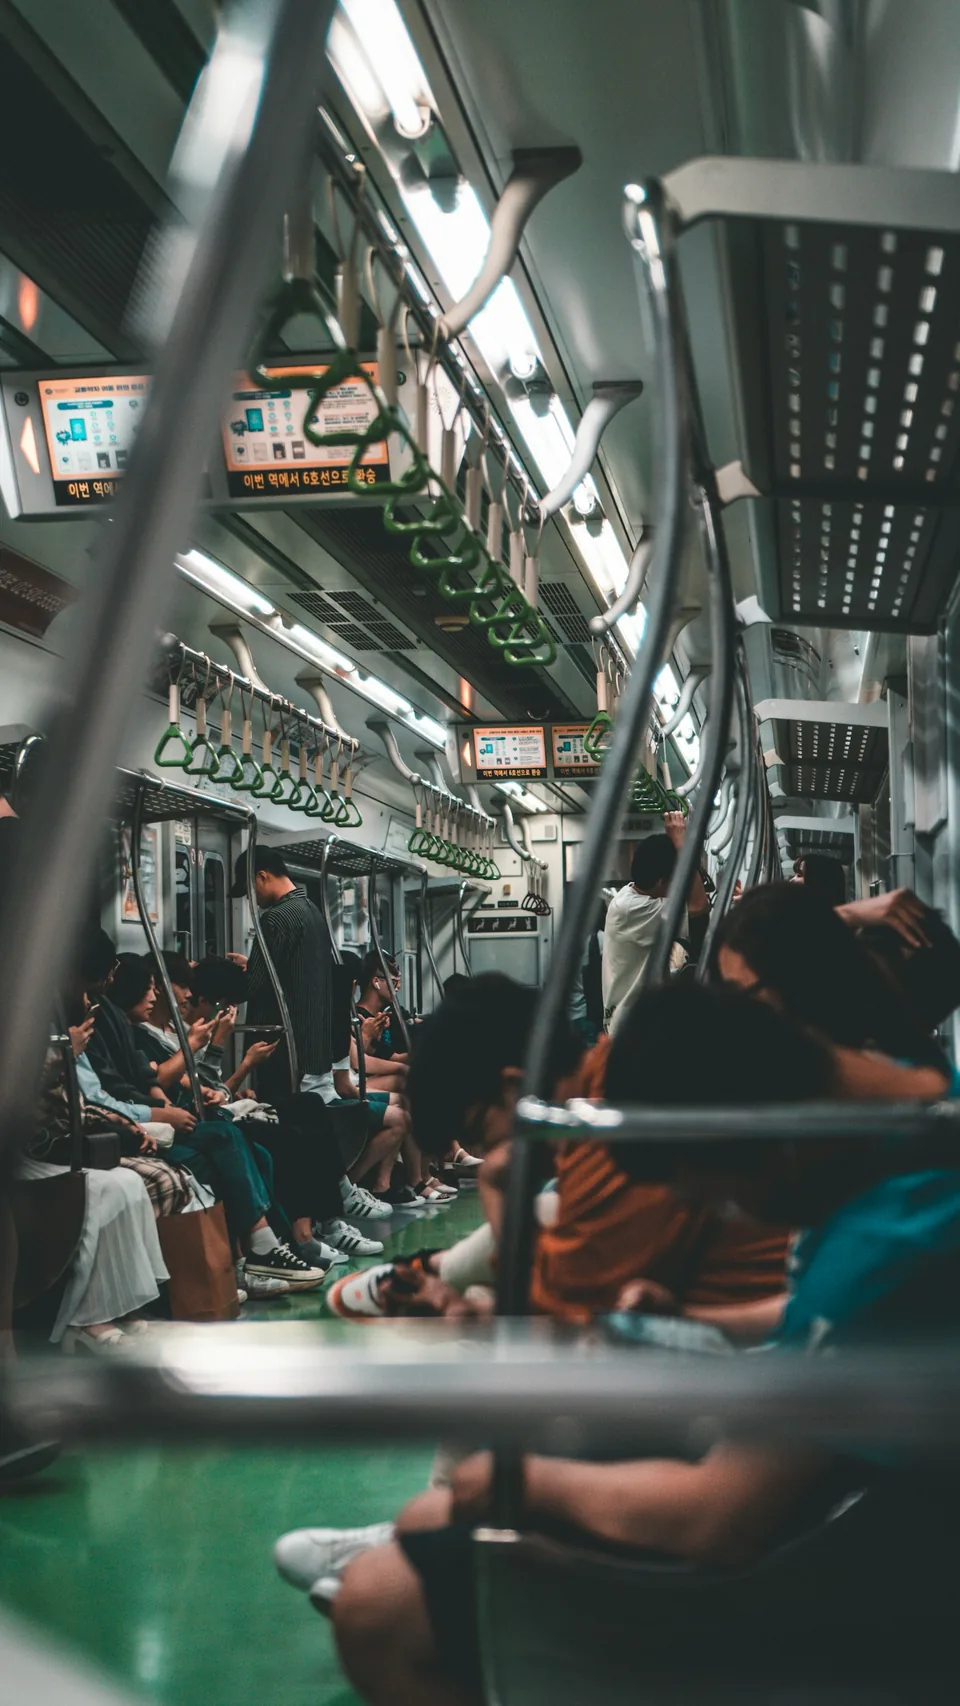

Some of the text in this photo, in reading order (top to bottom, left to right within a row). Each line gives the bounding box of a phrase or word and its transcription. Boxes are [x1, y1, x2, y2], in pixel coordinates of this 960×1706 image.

[243, 474, 265, 490] 이번
[268, 472, 300, 488] 역에서
[303, 469, 350, 486] 6호선으로
[68, 481, 118, 498] 이번 역에
